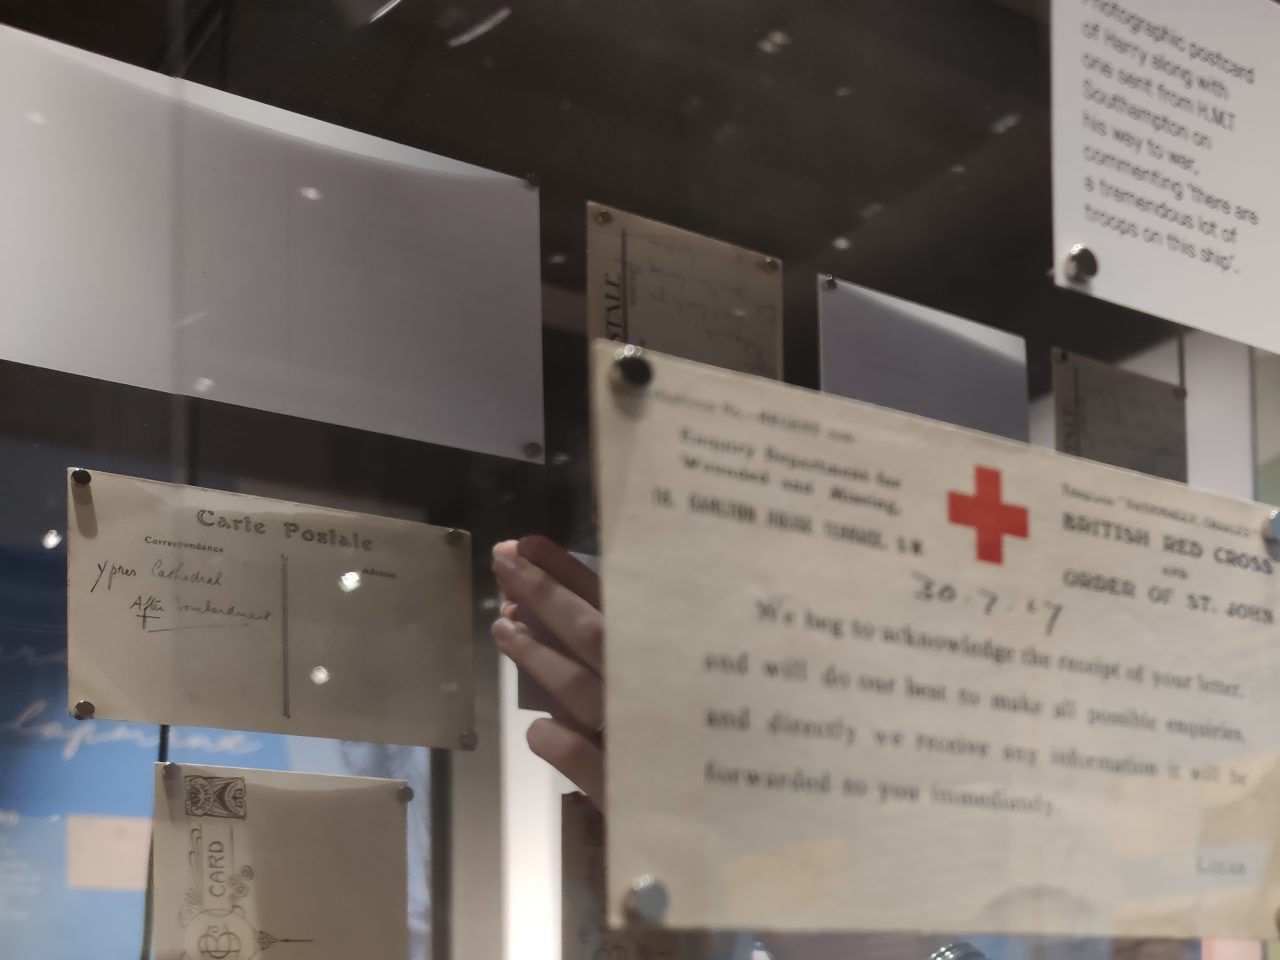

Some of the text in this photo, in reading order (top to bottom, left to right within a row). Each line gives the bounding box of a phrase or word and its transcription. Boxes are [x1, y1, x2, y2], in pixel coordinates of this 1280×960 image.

[196, 508, 375, 553] Carte Postale
[1063, 512, 1277, 575] BRITISH RED CROSS
[1062, 570, 1274, 624] ORDER OF ST. JOHN
[209, 839, 226, 898] CARD
